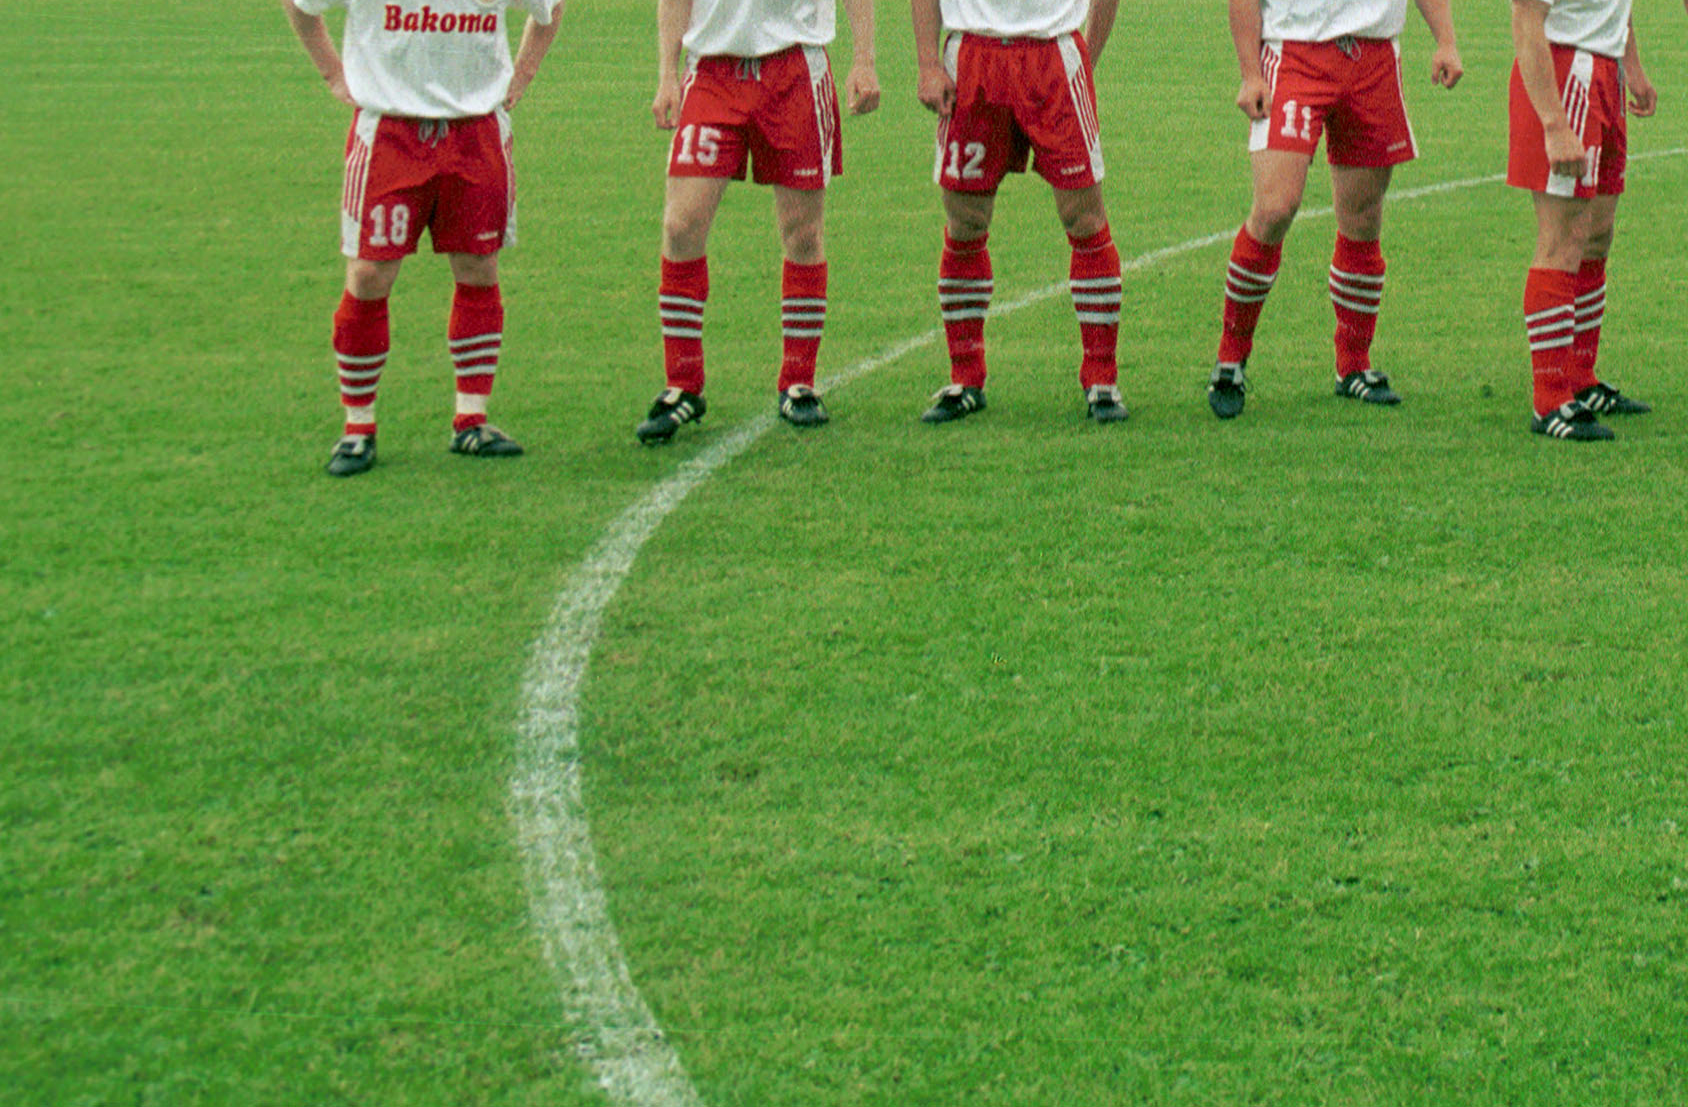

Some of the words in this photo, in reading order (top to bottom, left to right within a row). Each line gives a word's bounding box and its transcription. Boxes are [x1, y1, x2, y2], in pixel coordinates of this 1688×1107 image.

[384, 4, 498, 34] Bakoma
[1280, 99, 1312, 141] 11
[677, 124, 721, 165] 15
[944, 141, 985, 179] 12
[369, 204, 410, 246] 18
